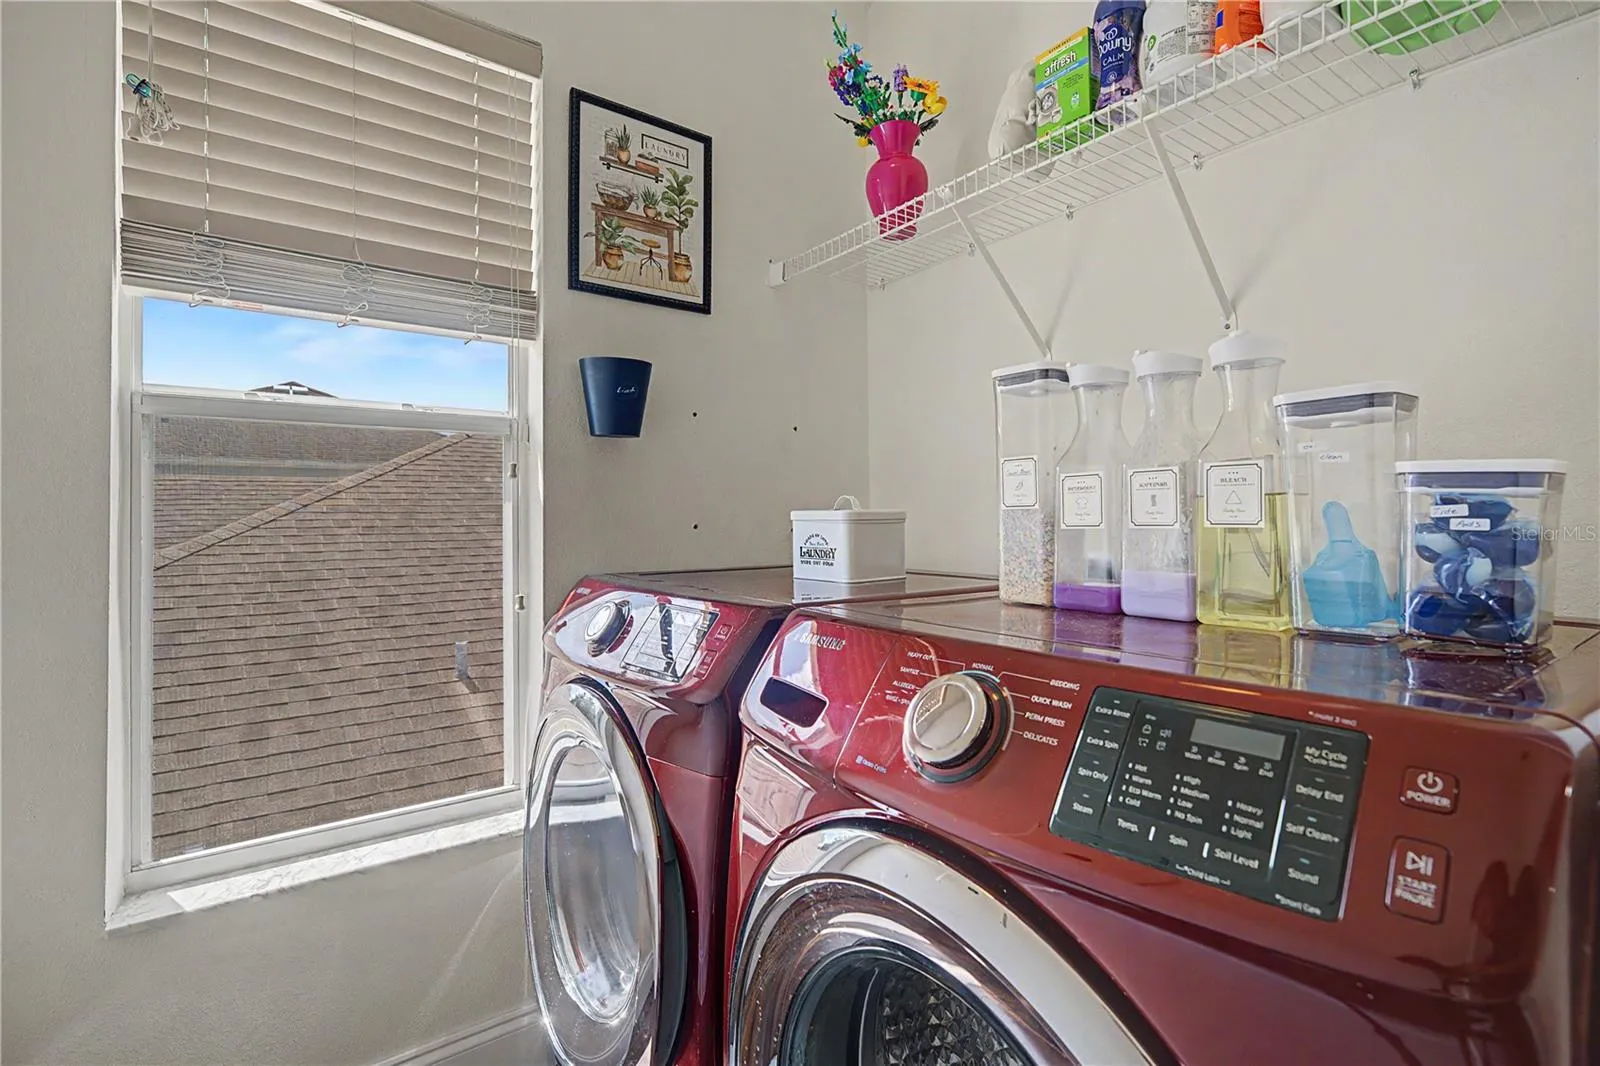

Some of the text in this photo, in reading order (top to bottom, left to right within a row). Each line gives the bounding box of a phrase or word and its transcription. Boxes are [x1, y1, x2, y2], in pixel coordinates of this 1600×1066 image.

[1044, 51, 1077, 77] affresh
[1102, 53, 1125, 66] CALM
[645, 141, 686, 161] LAUNDRY
[800, 546, 837, 560] LAUNDRY
[800, 632, 846, 651] SAMSUNG
[971, 662, 994, 671] NORMAL
[1050, 679, 1080, 691] BEDDING
[1031, 695, 1073, 709] QUICK WASH
[1095, 706, 1113, 715] Extra
[1025, 712, 1066, 727] PERM PRESS
[1023, 731, 1059, 746] DELICATES
[1086, 736, 1119, 749] Extra Spin
[1305, 746, 1348, 763] My Cycle
[1078, 767, 1109, 782] Spin Only
[1180, 787, 1210, 800] Medium
[1295, 783, 1344, 803] Delay End
[1405, 790, 1451, 808] POWER
[1072, 801, 1093, 815] Steam
[1125, 797, 1141, 807] Cold
[1177, 798, 1193, 808] Low
[1236, 801, 1264, 816] Heavy
[1174, 810, 1203, 824] No Spin
[1233, 814, 1264, 829] Normal
[1230, 826, 1253, 840] Light
[1285, 822, 1305, 834] Self
[1169, 834, 1189, 848] Spin
[1214, 847, 1259, 869] Soil Level
[1287, 867, 1320, 885] Sound
